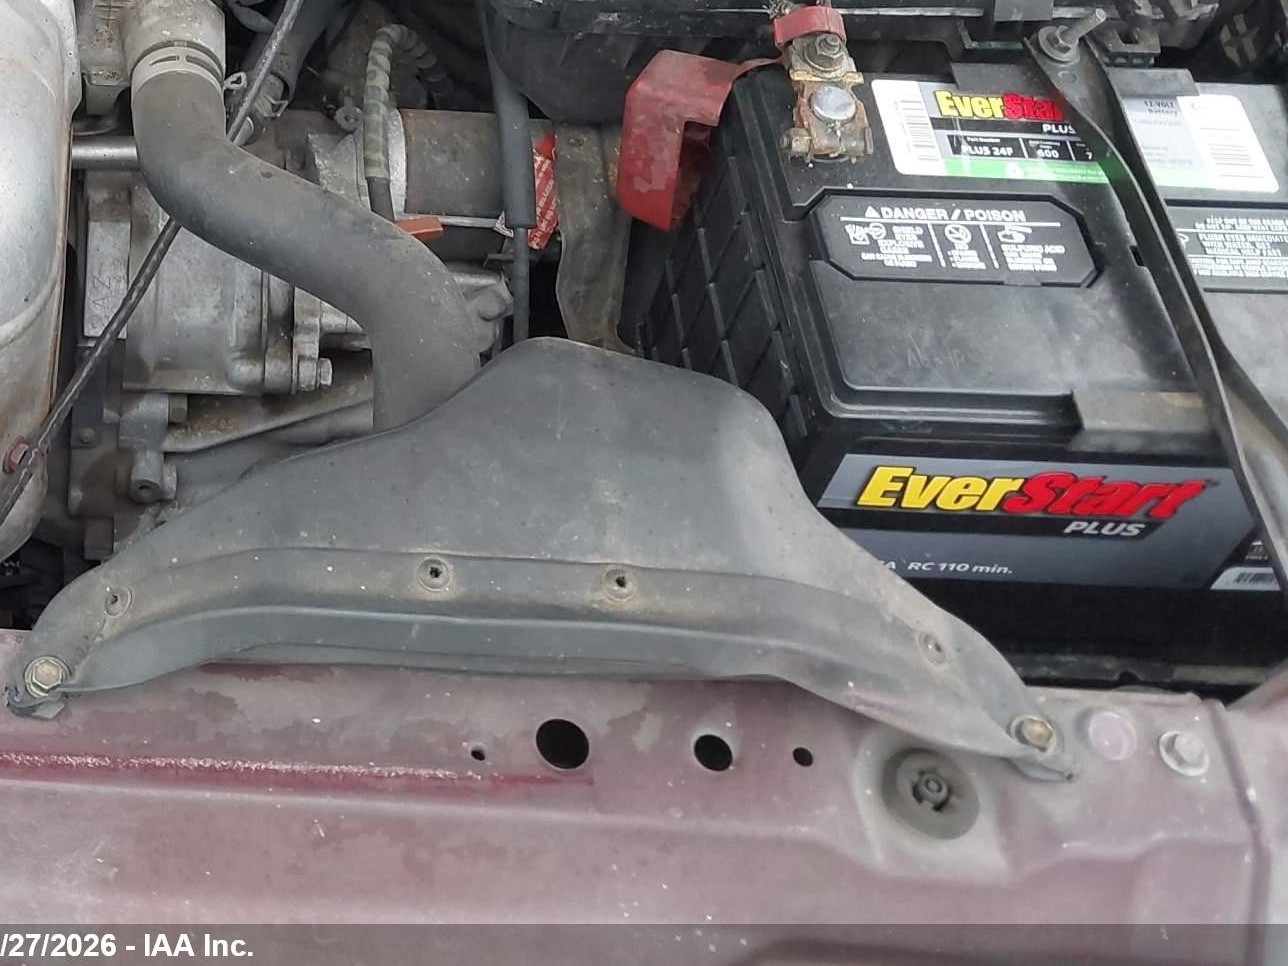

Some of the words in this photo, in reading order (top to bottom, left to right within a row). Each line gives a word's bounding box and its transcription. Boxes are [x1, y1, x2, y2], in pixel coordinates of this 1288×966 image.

[1042, 123, 1076, 134] PLUS
[961, 145, 991, 155] PLUS
[1037, 149, 1059, 159] 600
[880, 207, 949, 220] DANGER
[964, 209, 1026, 222] POISON
[857, 465, 1212, 520] EverStart
[1063, 521, 1146, 536] PLUS
[907, 562, 935, 571] RC
[938, 563, 970, 572] 110
[972, 564, 1013, 574] min.
